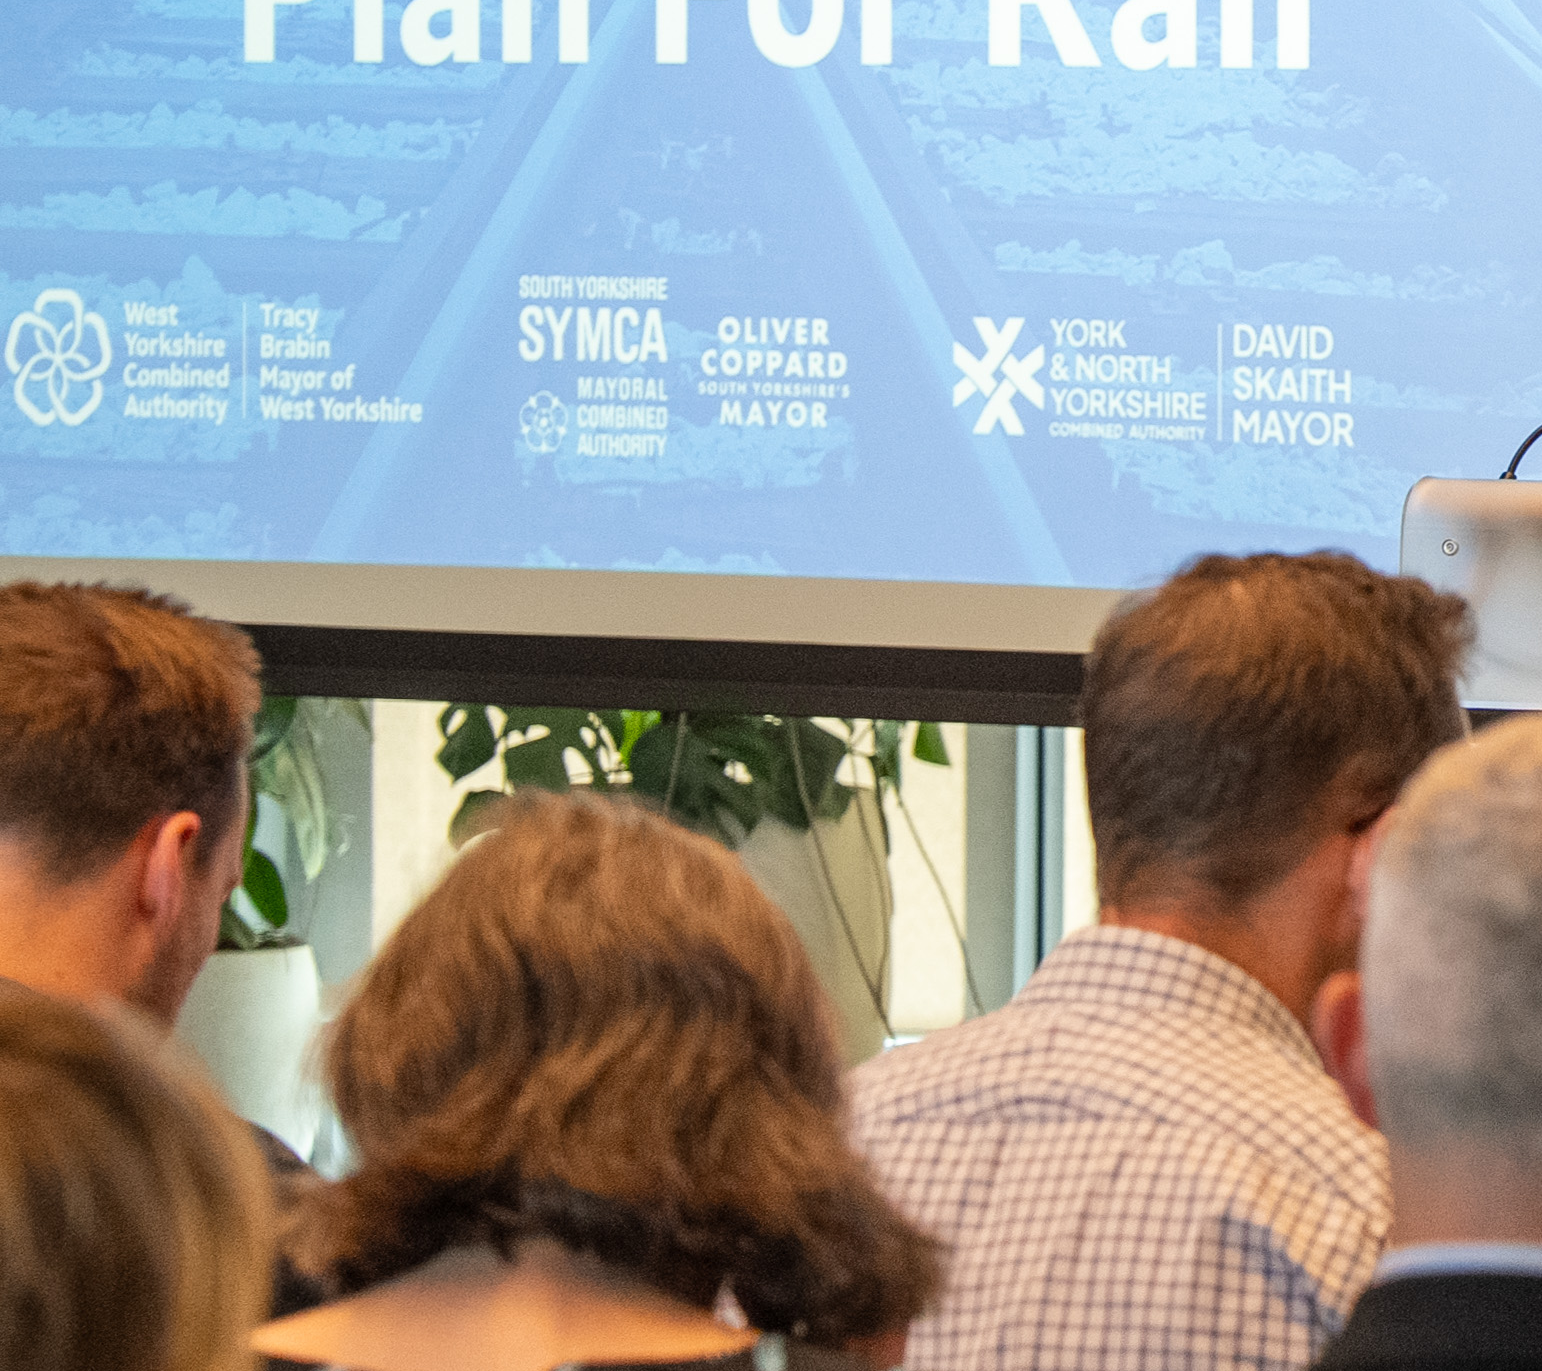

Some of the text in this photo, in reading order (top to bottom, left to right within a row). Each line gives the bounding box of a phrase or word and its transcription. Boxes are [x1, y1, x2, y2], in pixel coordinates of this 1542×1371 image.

[519, 275, 668, 301] SOUTH YORKSHIRE
[124, 302, 179, 326] West
[259, 302, 320, 333] Tracy
[124, 331, 226, 358] Yorkshire
[260, 330, 331, 359] Brabin
[519, 305, 668, 364] SYMCA
[718, 316, 829, 345] OLIVER
[1050, 318, 1127, 348] YORK
[1233, 323, 1334, 360] DAVID
[123, 362, 230, 388] Combined
[701, 348, 847, 378] COPPARD
[1049, 353, 1171, 383] & NORTH
[259, 363, 356, 395] Mayor of
[577, 376, 668, 401] MAYORAL
[698, 381, 747, 395] SOUTH
[1233, 366, 1352, 404] SKAITH
[123, 393, 229, 426] Authority
[260, 396, 423, 423] West Yorkshire
[576, 404, 668, 430] COMBINED
[719, 400, 827, 428] MAYOR
[1050, 387, 1206, 420] YORKSHIRE
[1049, 422, 1205, 440] COMBINED AUTHORITY
[1233, 409, 1354, 447] MAYOR
[576, 433, 667, 457] AUTHORITY
